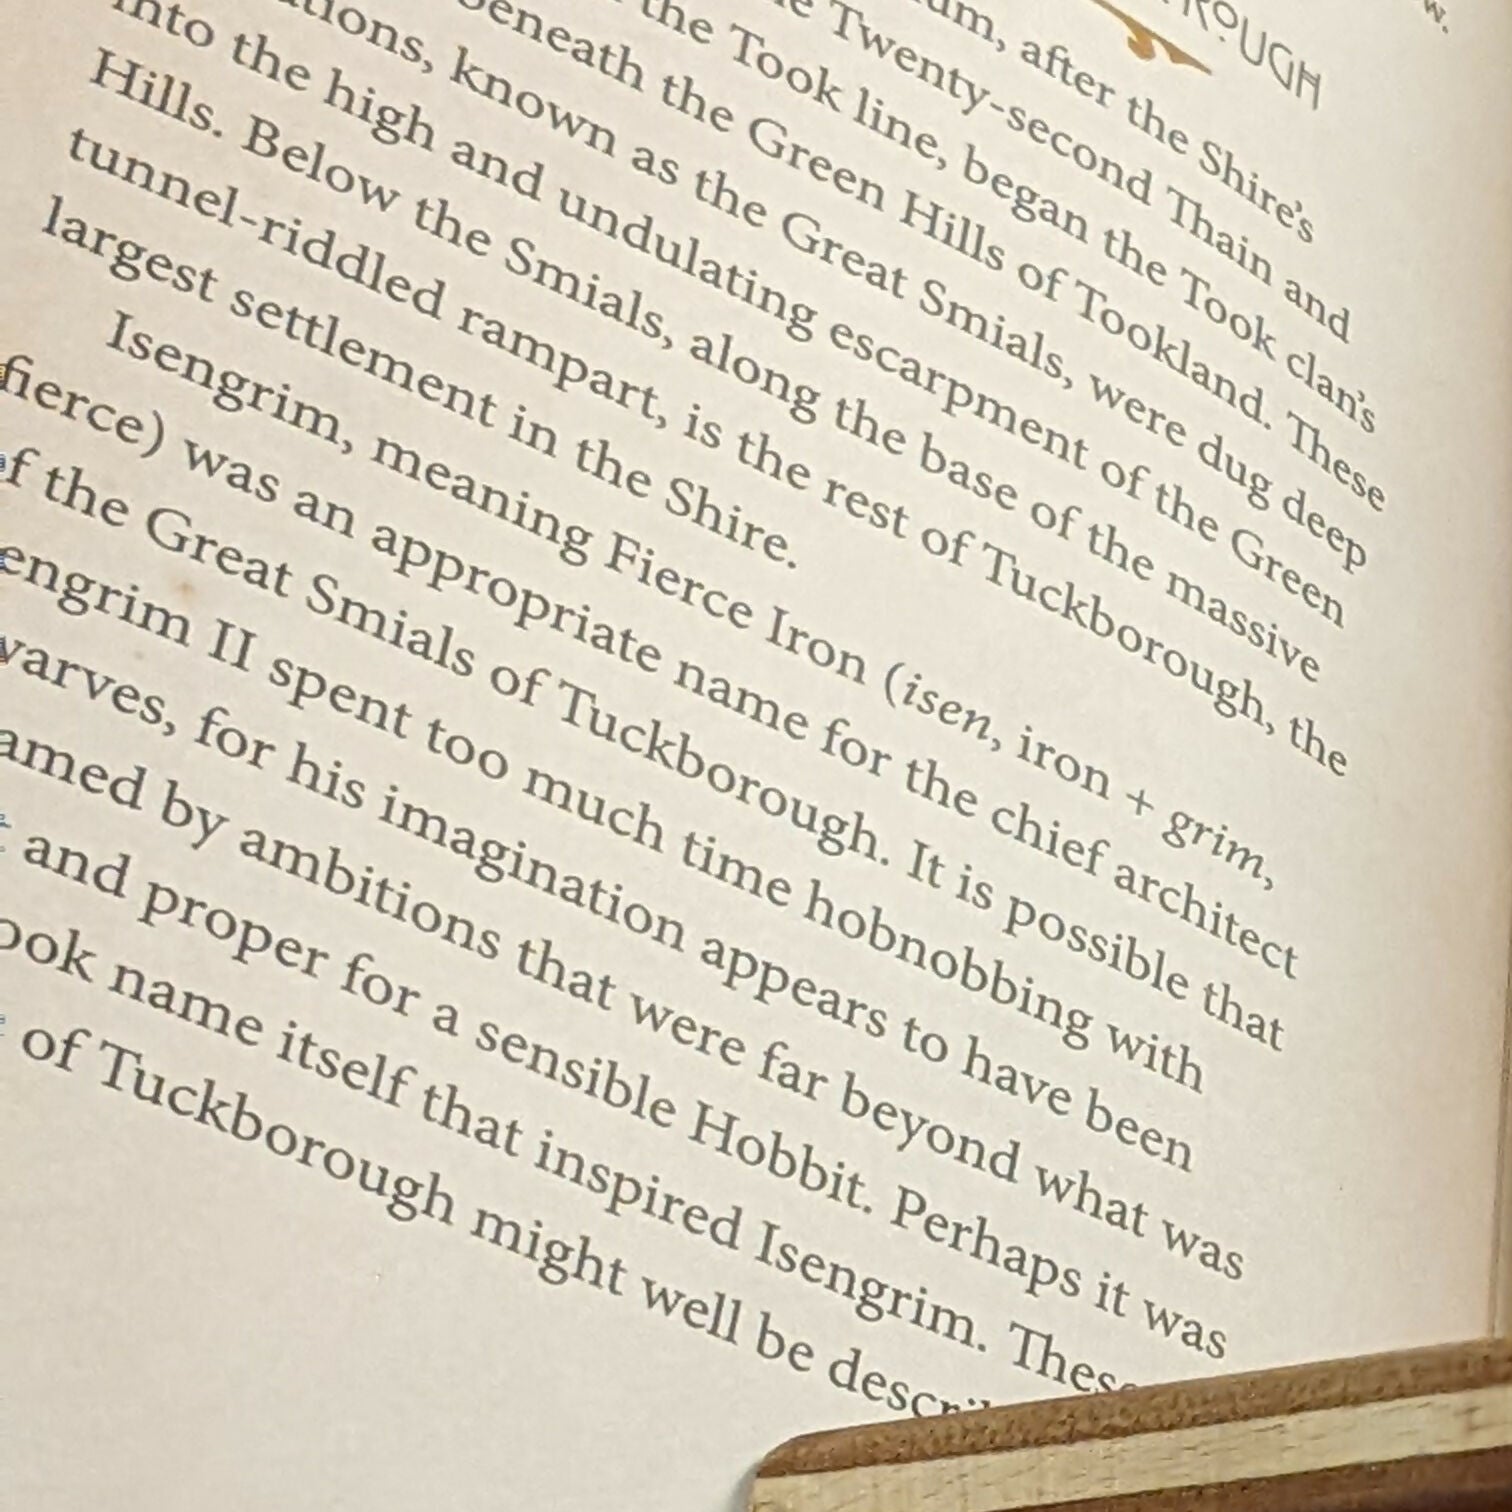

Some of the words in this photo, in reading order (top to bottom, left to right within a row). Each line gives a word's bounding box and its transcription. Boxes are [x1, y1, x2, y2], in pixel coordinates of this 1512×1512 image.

[42, 194, 218, 303] largest
[230, 290, 497, 427] settlement
[508, 404, 556, 458] in
[577, 439, 651, 498] the
[665, 478, 796, 569] Shire.
[70, 128, 445, 320] tunnel-riddled
[457, 307, 667, 429] rampart,
[683, 403, 722, 448] is
[738, 432, 810, 490] the
[822, 479, 909, 539] rest
[922, 528, 976, 567] of
[982, 542, 1275, 735] Tuckborough,
[1290, 717, 1347, 777] the
[450, 45, 615, 158] known
[632, 147, 679, 185] as
[696, 170, 767, 227] the
[782, 212, 908, 299] Great
[919, 279, 1073, 390] Smials,
[1089, 374, 1186, 447] were
[1198, 433, 1273, 511] dug
[1283, 488, 1366, 575] deep
[729, 23, 843, 113] Took
[853, 87, 947, 170] line,
[964, 143, 1088, 244] began
[1104, 229, 1167, 286] the
[1180, 267, 1276, 361] Took
[1287, 352, 1375, 433] clan's
[45, 466, 129, 527] the
[146, 508, 293, 598] Great
[306, 574, 475, 676] Smials
[491, 666, 551, 706] of
[557, 678, 889, 866] Tuckborough.
[907, 839, 945, 889] It
[955, 864, 993, 910] is
[1002, 895, 1189, 1000] possible
[1203, 982, 1284, 1052] that
[106, 310, 353, 455] Isengrim,
[370, 437, 594, 567] meaning
[604, 531, 753, 629] Fierce
[765, 605, 865, 685] Iron
[885, 662, 1001, 752] (isen,
[1017, 725, 1109, 800] iron
[1126, 789, 1154, 815] +
[1161, 811, 1273, 891] grim,
[22, 1028, 92, 1072] of
[99, 1039, 453, 1226] Tuckborough
[470, 1209, 628, 1296] might
[641, 1276, 742, 1345] well
[756, 1311, 814, 1372] be
[24, 837, 131, 898] and
[137, 882, 330, 978] proper
[340, 953, 421, 1017] for
[433, 1004, 458, 1037] a
[475, 1022, 676, 1128] sensible
[688, 1100, 872, 1214] Hobbit.
[890, 1185, 1081, 1298] Perhaps
[1094, 1271, 1130, 1317] it
[1143, 1299, 1226, 1359] was
[194, 706, 276, 770] for
[286, 740, 365, 808] his
[378, 784, 684, 953] imagination
[701, 938, 887, 1037] appears
[904, 1017, 948, 1062] to
[961, 1034, 1072, 1115] have
[1086, 1086, 1192, 1173] been
